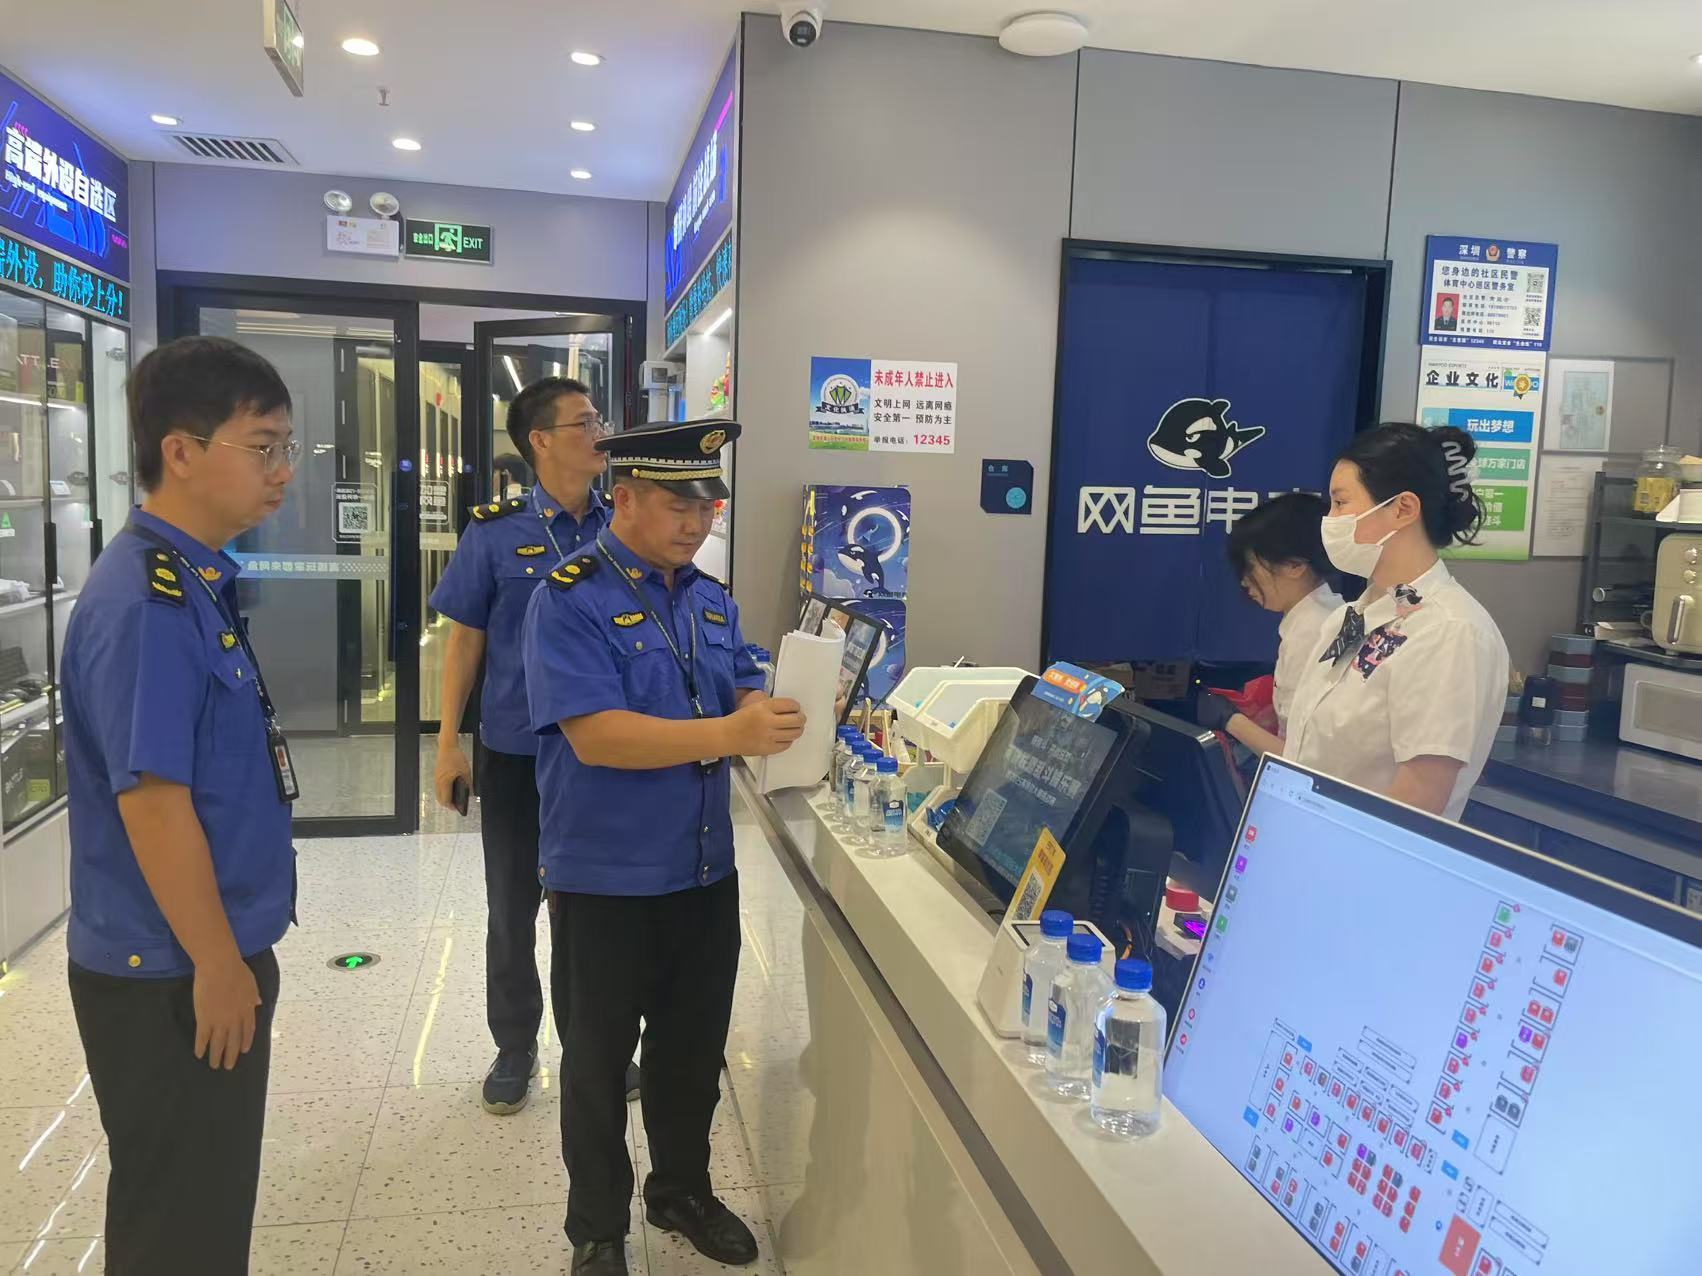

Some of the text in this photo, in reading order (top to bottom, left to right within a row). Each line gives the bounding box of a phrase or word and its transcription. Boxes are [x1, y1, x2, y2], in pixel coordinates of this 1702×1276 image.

[5, 126, 117, 222] 高端外设自选区
[463, 237, 483, 250] EXIT
[1506, 247, 1527, 260] 警察
[1441, 265, 1518, 281] 您身边的社区民警
[874, 369, 954, 389] 未成年人禁止进入
[1425, 369, 1499, 389] 企业文化
[873, 398, 952, 411] 文明上网 远离网瘾
[873, 412, 952, 425] 安全第一 预防为主
[1466, 418, 1515, 434] 玩出梦想
[913, 434, 951, 446] 12345
